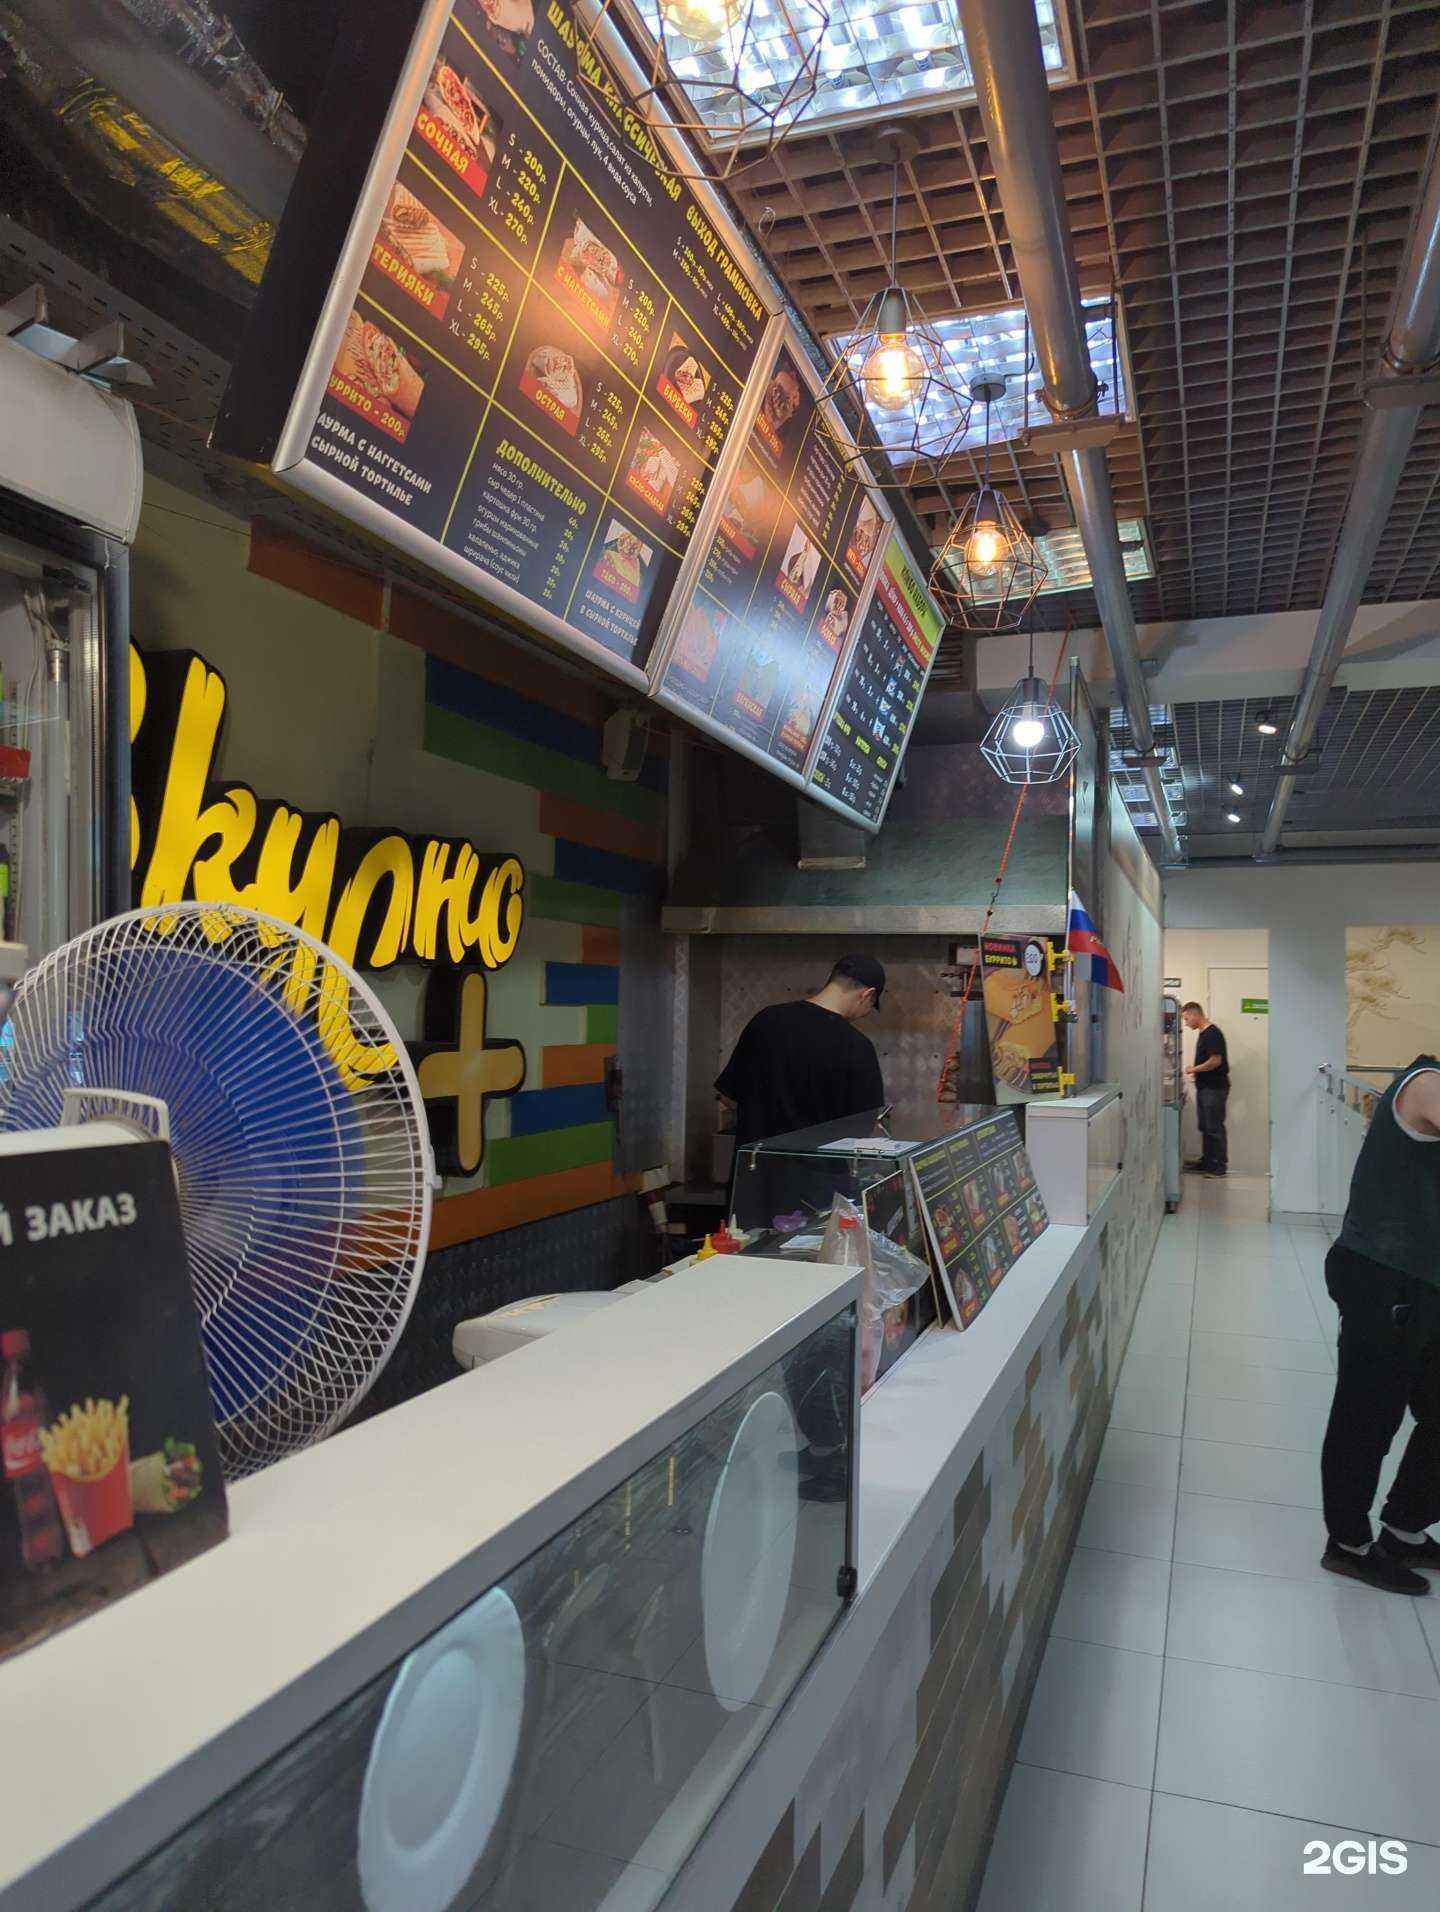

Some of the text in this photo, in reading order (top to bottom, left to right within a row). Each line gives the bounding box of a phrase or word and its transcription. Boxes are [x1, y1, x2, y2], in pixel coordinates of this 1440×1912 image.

[416, 110, 468, 174] СОЧНАЯ
[531, 59, 636, 206] помидоры, огурцы, лук, 4 вида соуса
[537, 39, 567, 84] СОСТАВ:
[565, 80, 588, 114] Сочная
[624, 163, 631, 175] из
[630, 173, 653, 207] капусты,
[501, 153, 542, 205] M 220р.
[508, 133, 548, 185] S 200р.
[487, 196, 529, 246] XL 270р.
[495, 176, 536, 226] L 240р.
[371, 243, 434, 305] ТЕРИЯКИ
[470, 256, 512, 304] S 225р.
[685, 204, 717, 255] ВЫХОД
[716, 249, 762, 320] ГРАММОВКА
[456, 299, 498, 343] L 265р.
[462, 277, 506, 322] M 245р.
[448, 319, 492, 362] XL 295р.
[535, 388, 565, 420] ОСТРАЯ
[595, 381, 603, 393] S
[663, 384, 693, 422] БАРБЕКЮ
[311, 432, 412, 505] СЫРНОЙ ТОРТИЛЬЕ
[356, 437, 366, 452] С
[367, 445, 431, 493] НАГГЕТСАМИ
[496, 438, 586, 516] ДОПОЛНИТЕЛЬНО
[507, 471, 517, 483] 30
[509, 508, 522, 523] фри
[130, 637, 527, 1092] кусно
[25, 1192, 137, 1242] ЗАКАЗ
